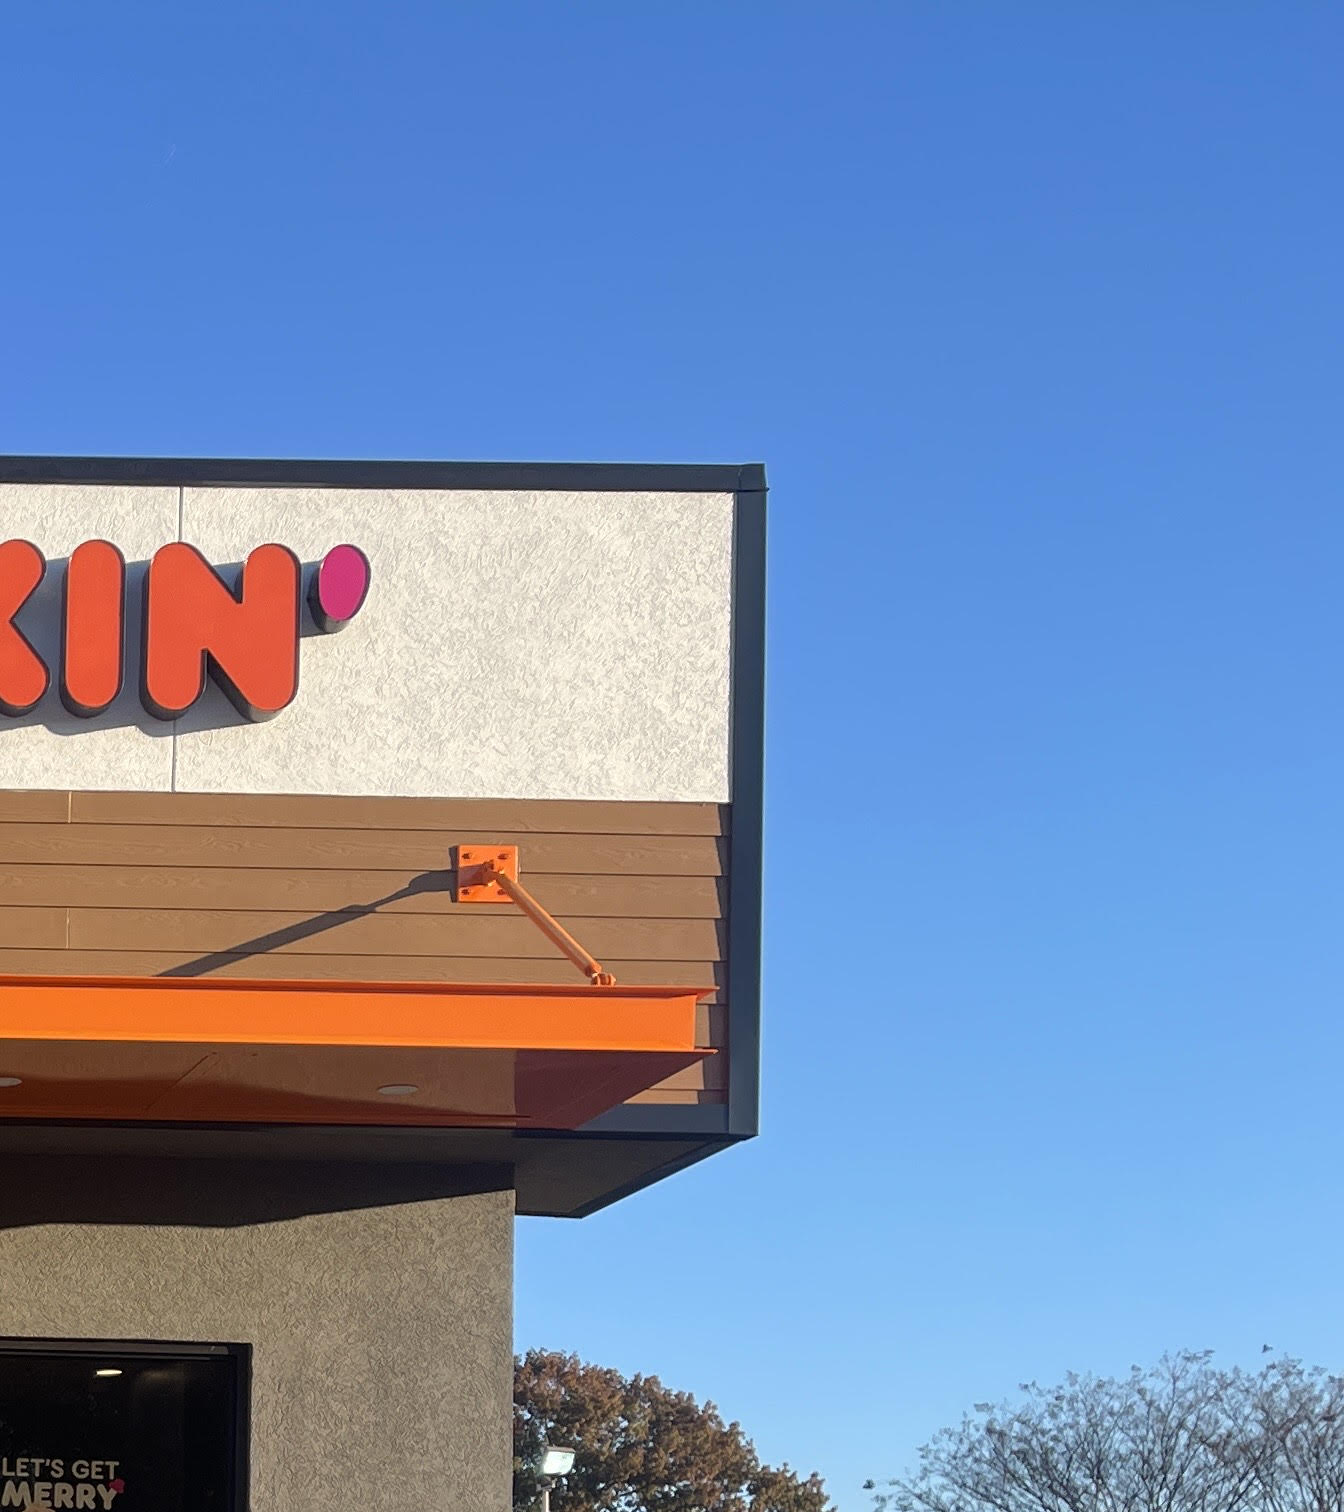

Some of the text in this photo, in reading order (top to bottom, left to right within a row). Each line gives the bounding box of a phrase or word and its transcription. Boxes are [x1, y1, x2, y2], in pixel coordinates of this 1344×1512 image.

[1, 1457, 120, 1480] LET'S GET
[1, 1480, 118, 1510] MERRY
